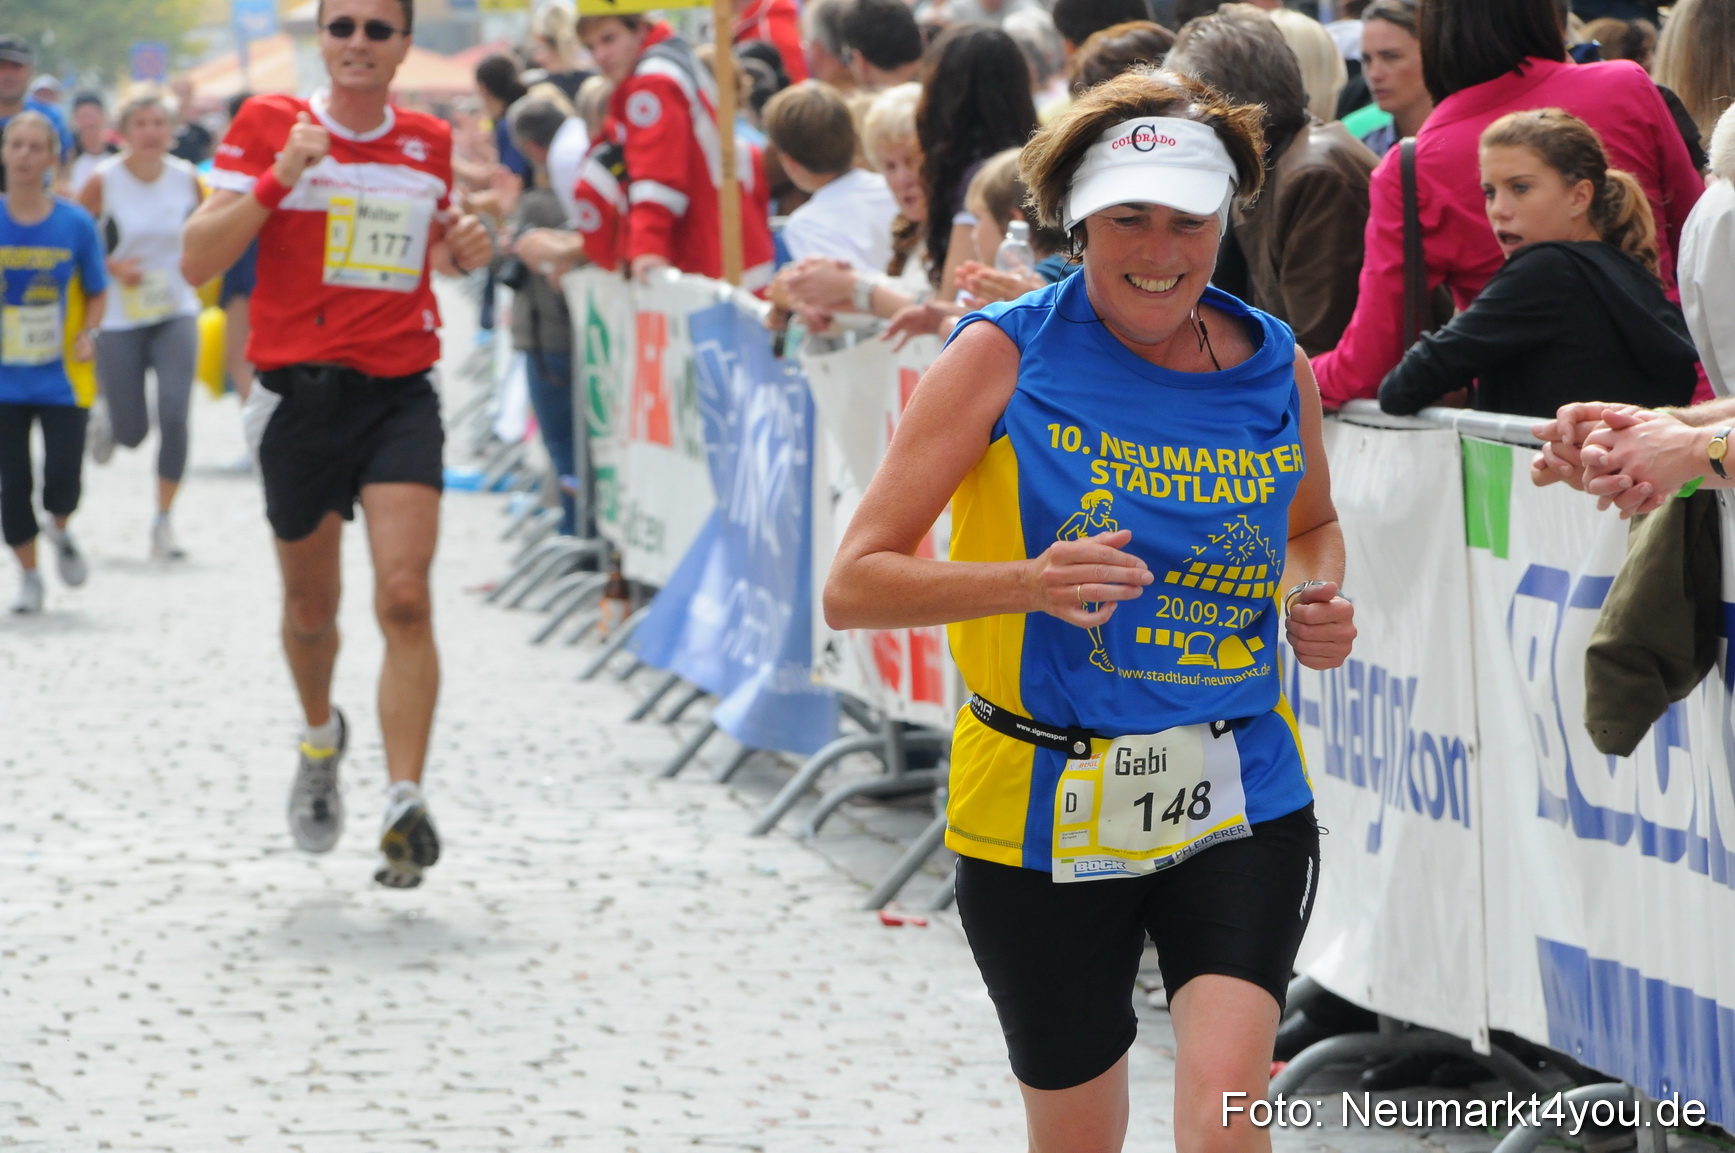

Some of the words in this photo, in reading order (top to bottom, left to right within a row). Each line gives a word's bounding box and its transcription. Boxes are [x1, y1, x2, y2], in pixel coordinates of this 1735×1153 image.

[1112, 134, 1176, 149] COLORADO
[1131, 124, 1156, 152] C
[358, 205, 400, 222] Walter
[369, 231, 413, 256] 177
[1048, 423, 1090, 454] 10.
[1101, 431, 1304, 477] NEUMARKTER
[1090, 459, 1275, 503] STADTLAUF
[1155, 595, 1263, 629] 20.09.20
[1115, 747, 1167, 776] Gabi
[1065, 792, 1077, 813] D
[1133, 780, 1212, 832] 148
[1175, 824, 1247, 859] PFLEIDERER
[1074, 860, 1127, 873] BOCK
